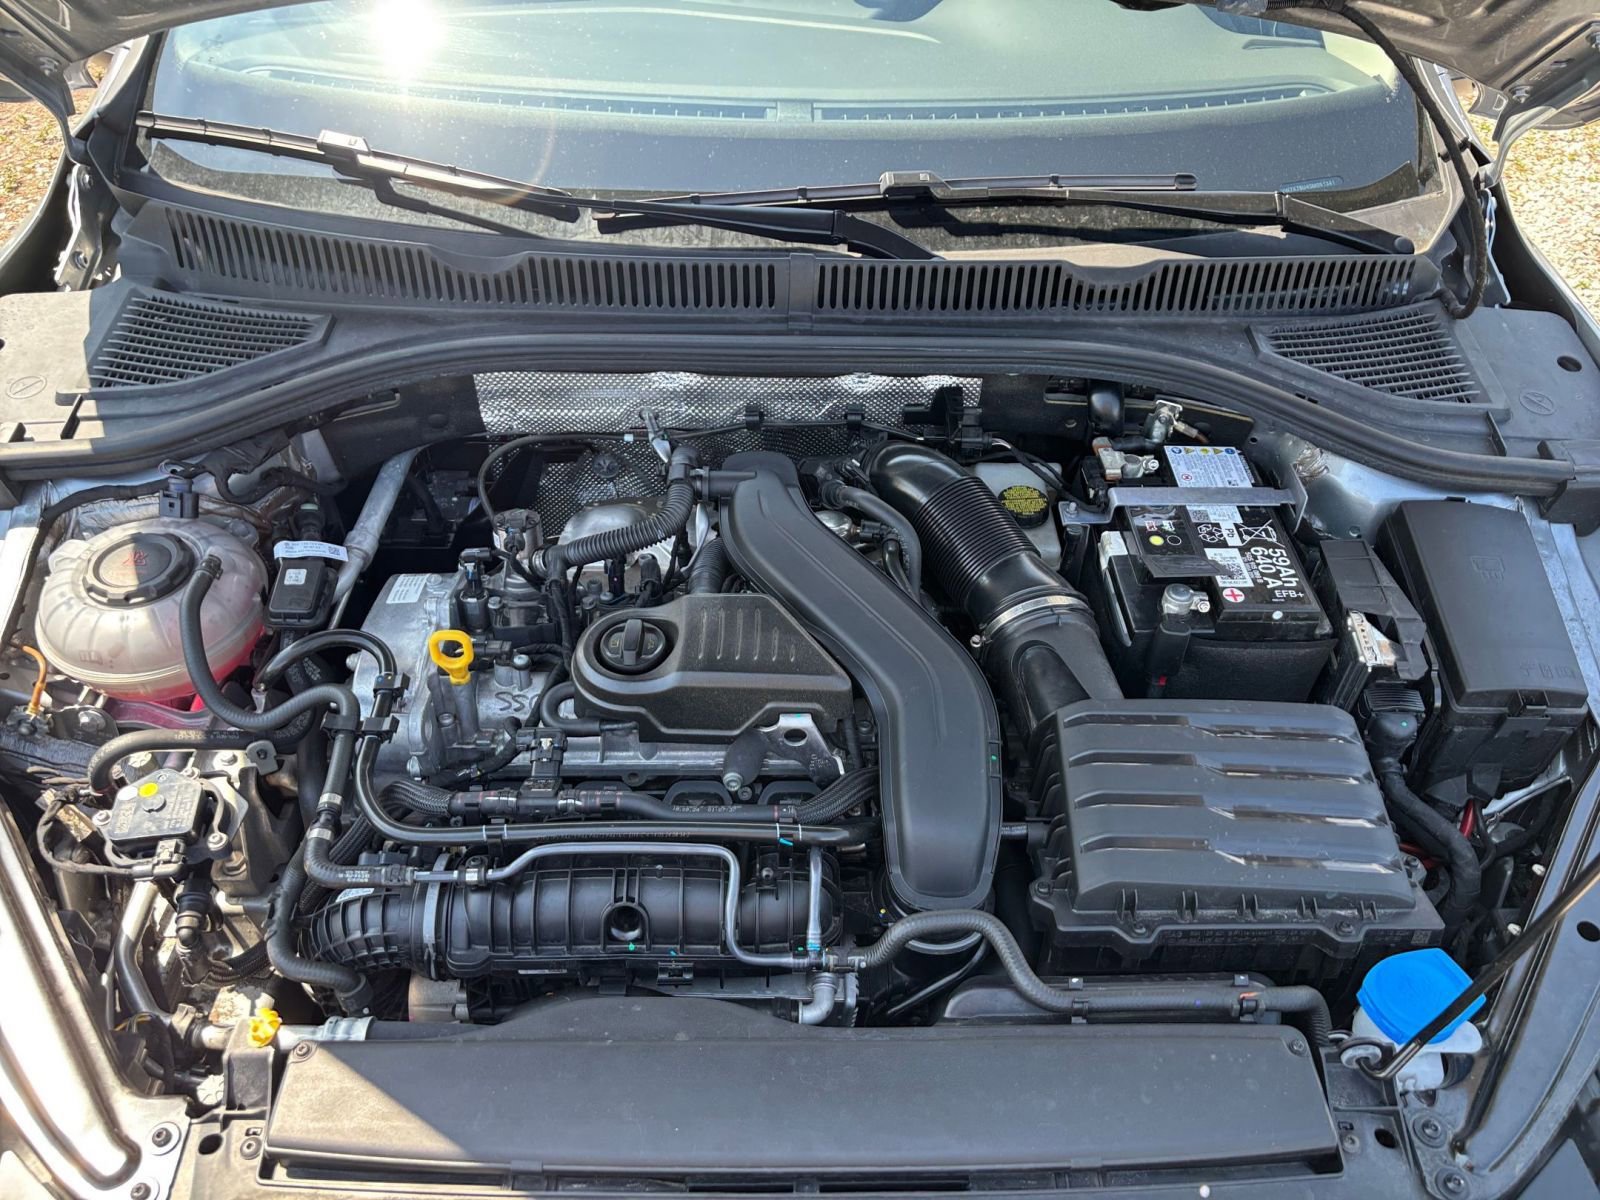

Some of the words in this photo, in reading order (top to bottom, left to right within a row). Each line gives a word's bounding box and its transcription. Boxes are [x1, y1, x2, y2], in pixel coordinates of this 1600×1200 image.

[1250, 546, 1277, 574] 640
[1268, 547, 1300, 588] 59Ah
[1262, 577, 1284, 589] A
[1274, 589, 1305, 598] EFB+
